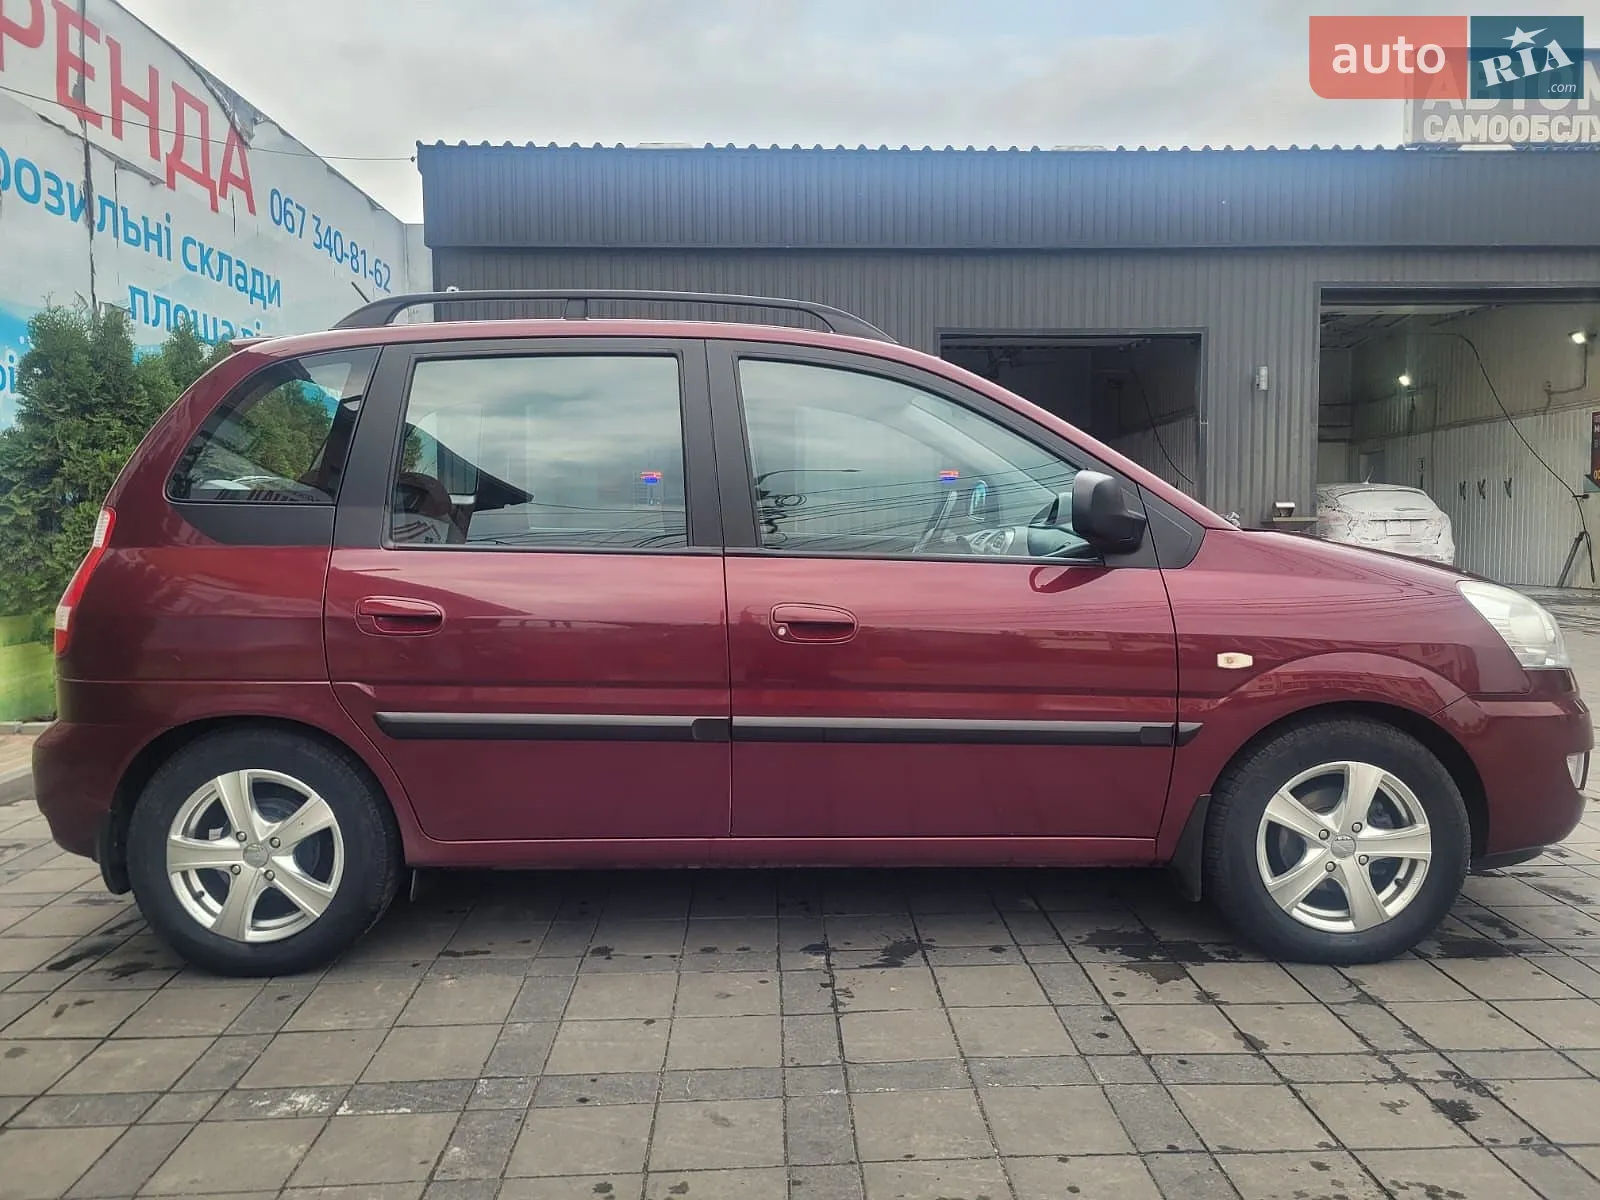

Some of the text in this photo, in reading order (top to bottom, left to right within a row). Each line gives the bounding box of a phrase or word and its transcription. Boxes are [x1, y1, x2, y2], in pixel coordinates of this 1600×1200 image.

[182, 236, 281, 311] склади
[270, 188, 391, 294] 067 340-81-62
